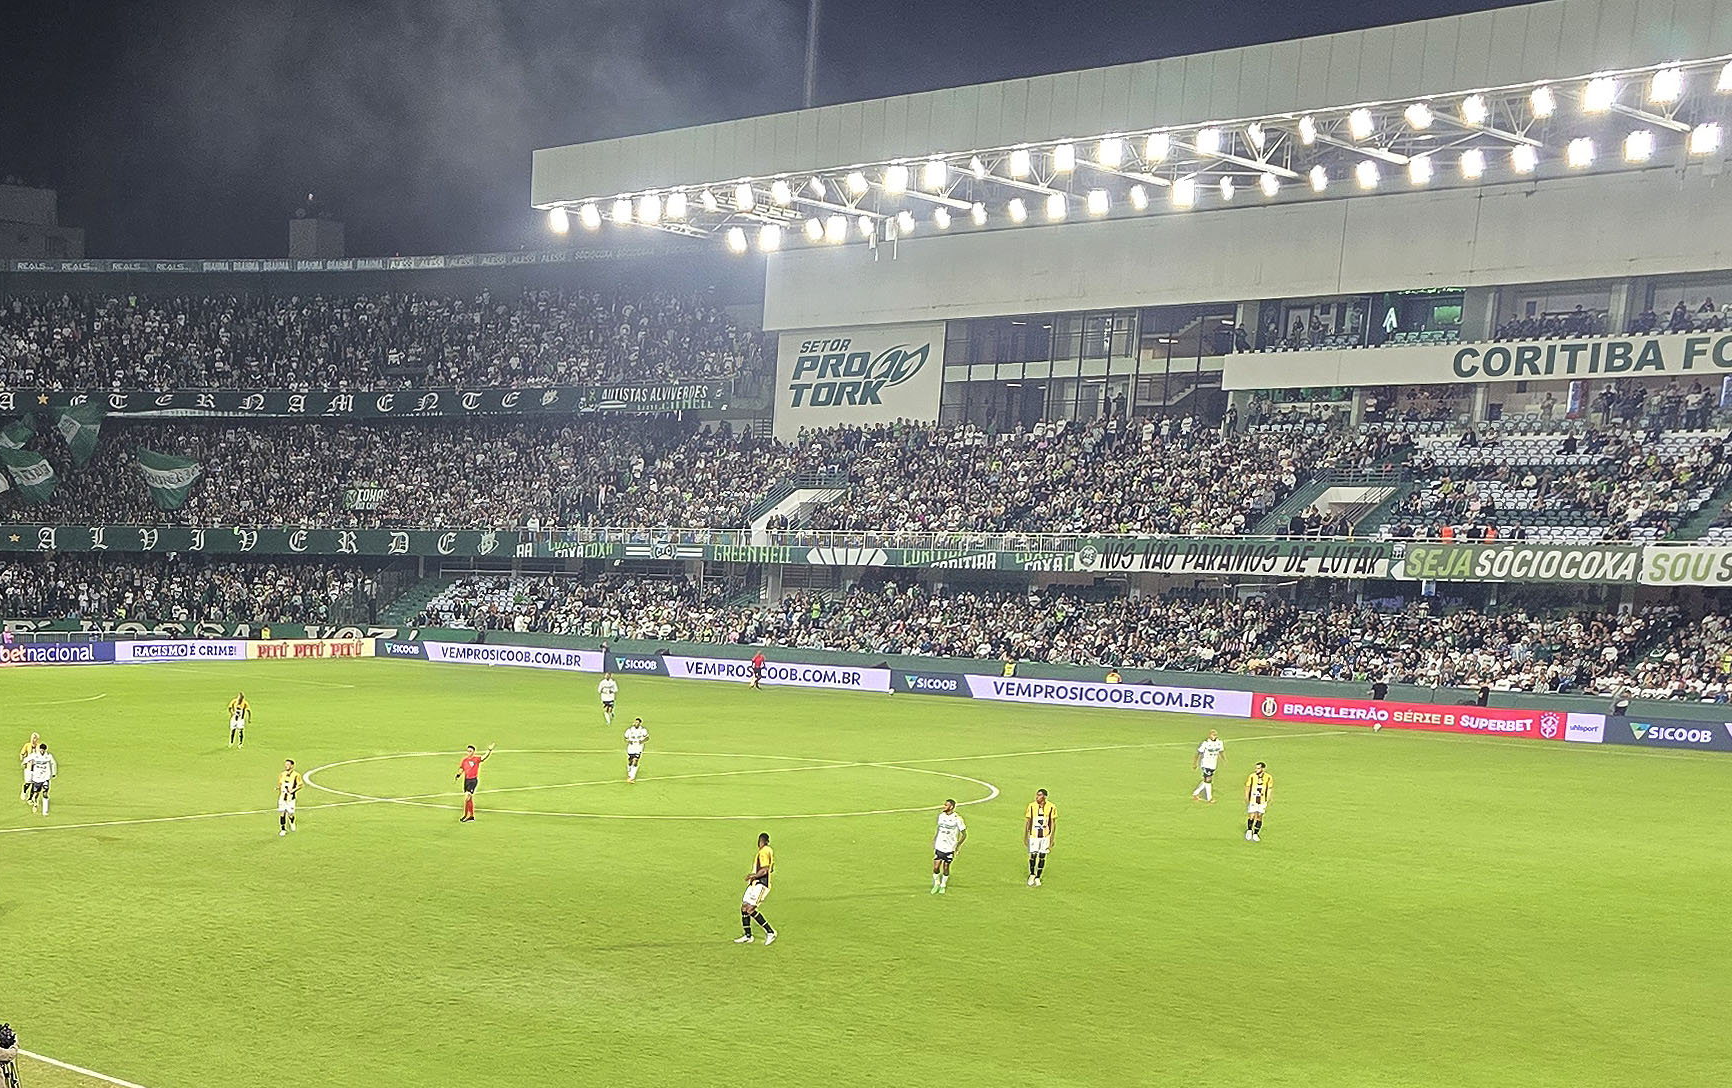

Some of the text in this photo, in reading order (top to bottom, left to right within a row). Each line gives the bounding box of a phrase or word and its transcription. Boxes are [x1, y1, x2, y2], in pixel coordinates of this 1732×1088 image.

[800, 338, 852, 353] SETOR
[792, 352, 872, 381] PRO
[1453, 340, 1666, 379] CORITIBA
[601, 385, 708, 402] AUTISTAS ALVIVERDES
[789, 379, 887, 408] TORK
[714, 544, 792, 564] GREEN HELL
[1181, 543, 1278, 574] PARAMOS
[1283, 545, 1315, 573] DE
[1317, 545, 1386, 576] LUTAR
[1406, 545, 1638, 581] SEJA SÓCIOCOXA
[1648, 552, 1715, 582] SOU
[0, 642, 94, 664] betnacional
[133, 645, 188, 657] RACISMO
[392, 644, 419, 655] SICOOB
[440, 646, 582, 667] VEMPROSICOOB.COM.BR
[624, 660, 658, 671] SICOOB
[685, 660, 862, 687] VEMPROSCOOB.COM.BR
[916, 677, 958, 691] SICOOB
[993, 680, 1216, 710] VEMPROSICOOB.COM.BR
[1283, 703, 1533, 732] BRASILEIRÃO SÉRIE B SUPERBET
[1648, 726, 1712, 743] SICOOB
